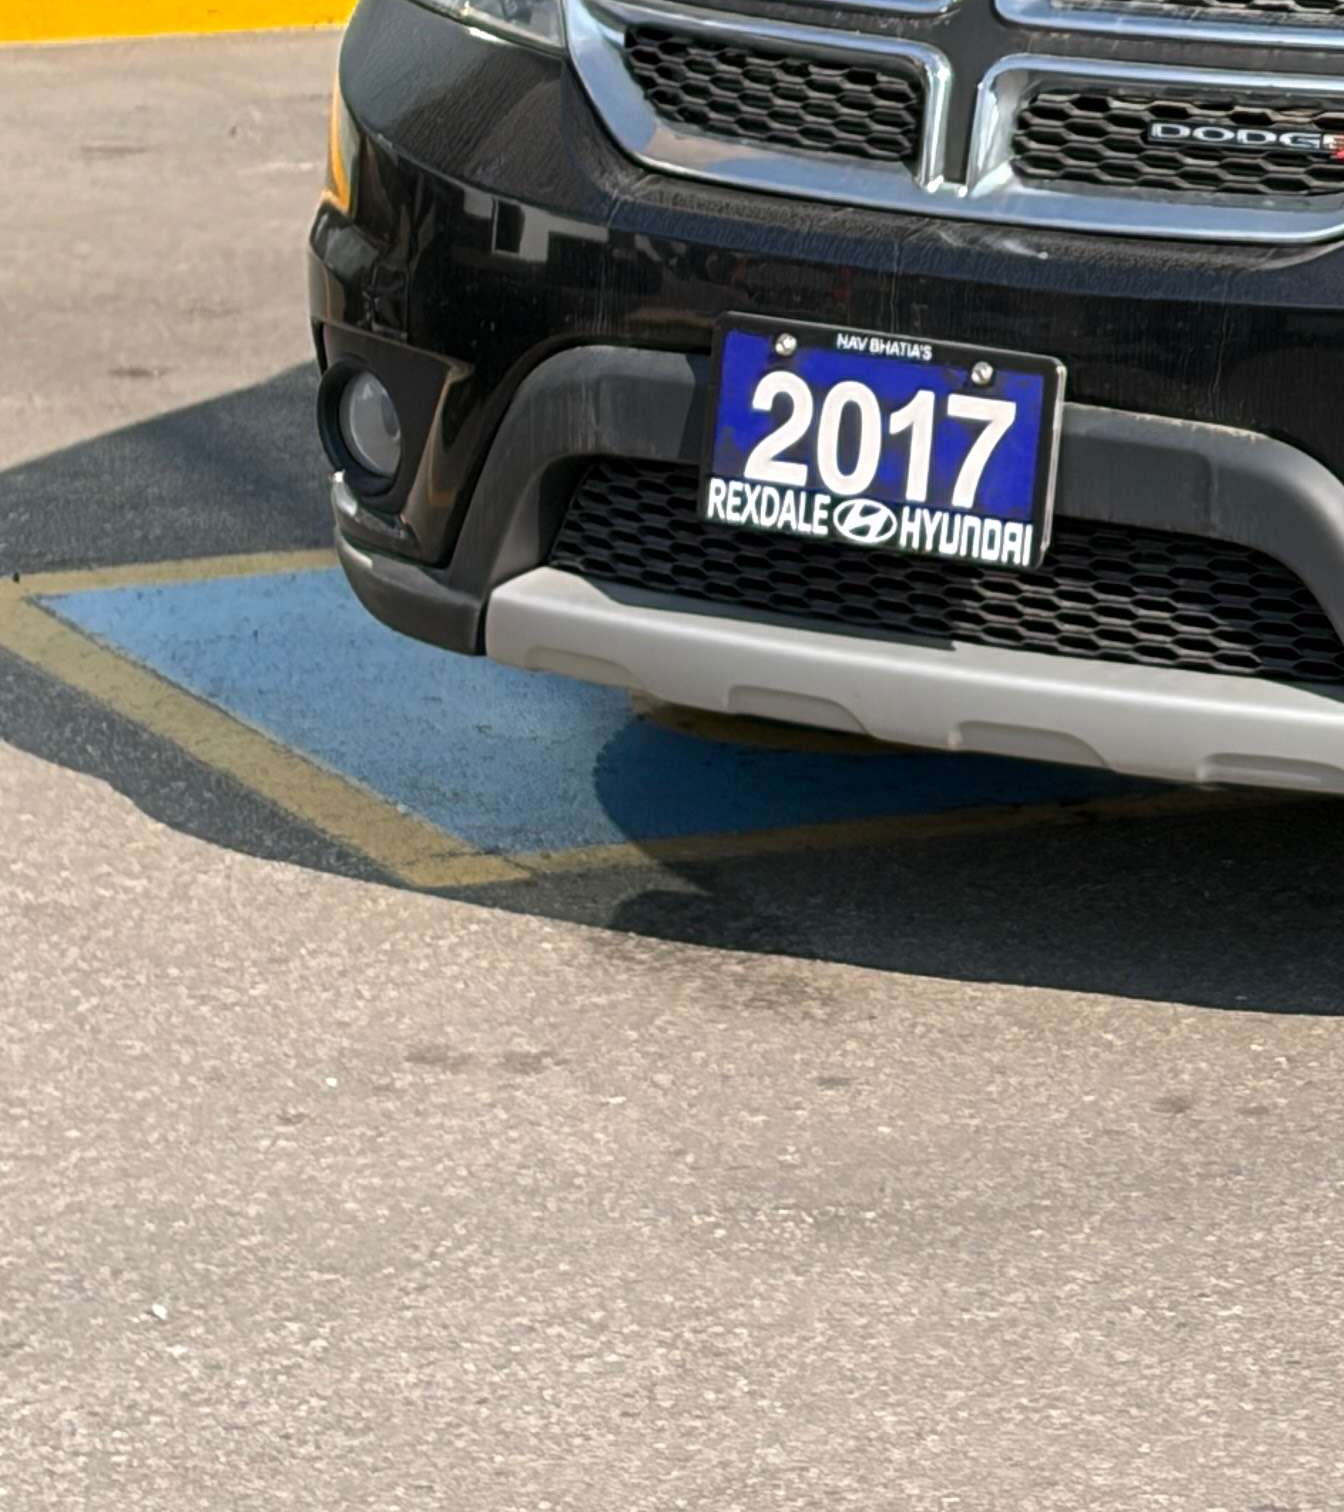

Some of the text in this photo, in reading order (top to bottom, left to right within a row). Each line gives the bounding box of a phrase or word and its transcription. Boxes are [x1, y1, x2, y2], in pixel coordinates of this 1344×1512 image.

[836, 332, 933, 362] NAV BHATIA'S
[744, 370, 1016, 509] 2017
[707, 478, 1034, 567] REXDALE HYUNDAI
